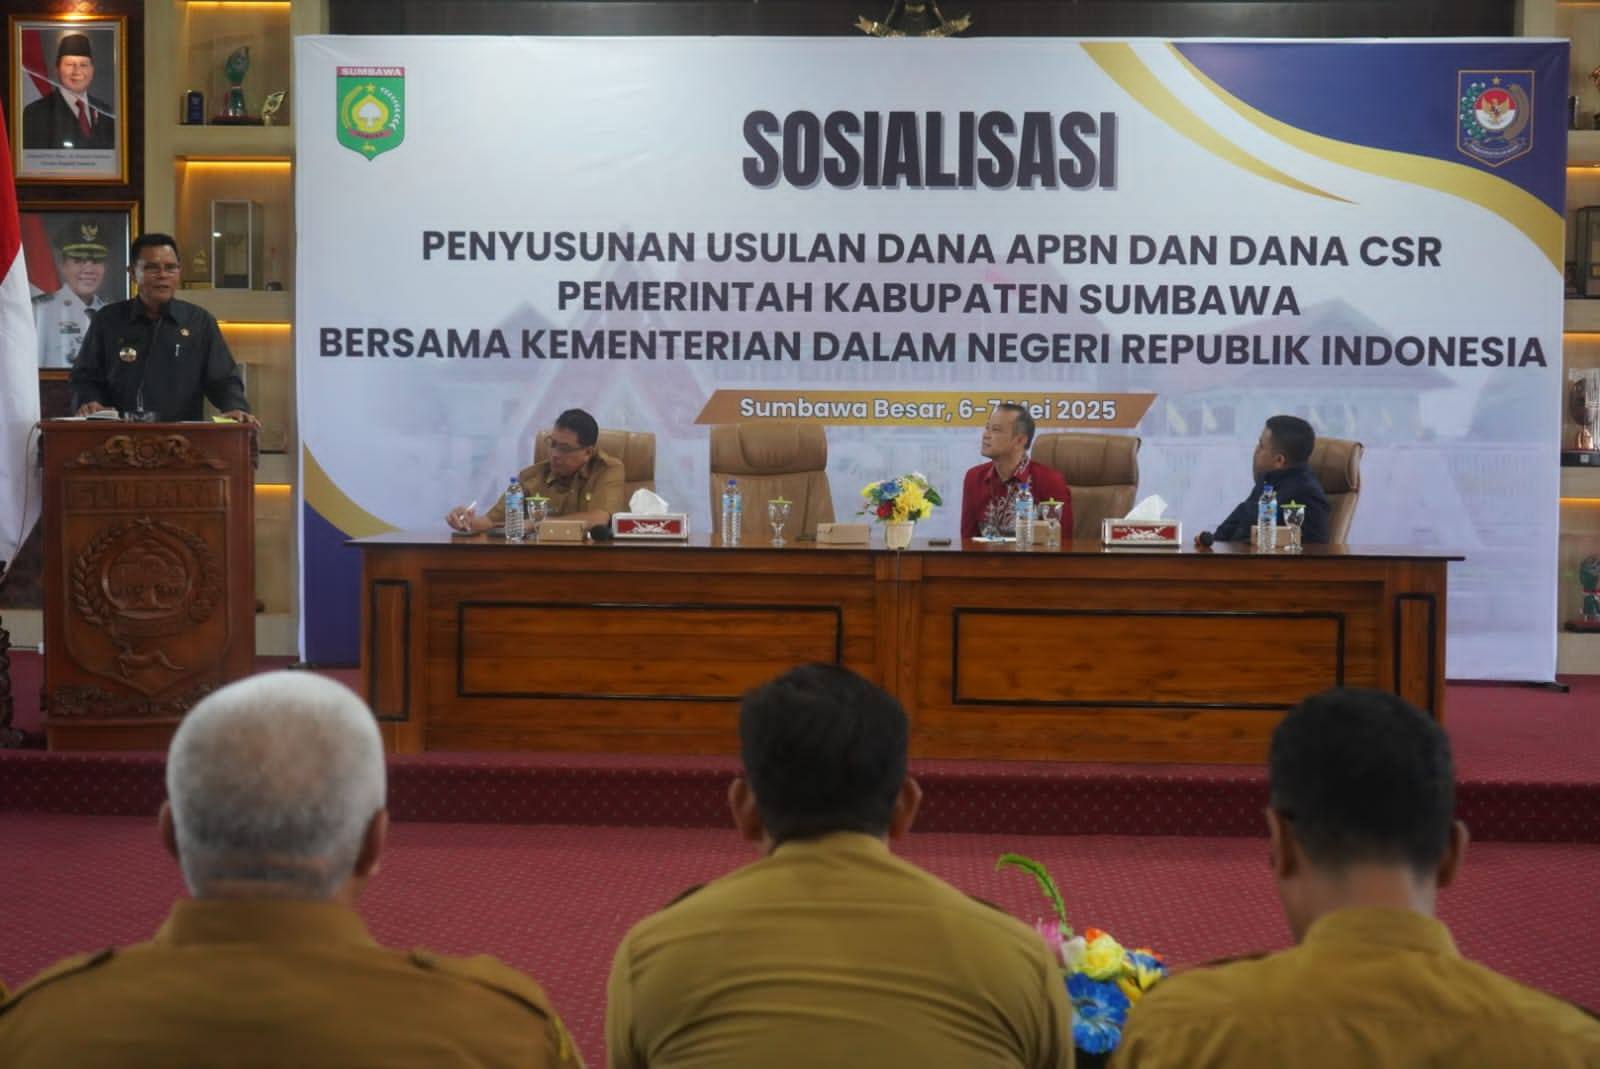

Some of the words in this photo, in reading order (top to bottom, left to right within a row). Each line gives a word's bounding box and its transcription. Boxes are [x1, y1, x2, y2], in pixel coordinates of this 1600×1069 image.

[340, 68, 401, 77] SUMBAWA
[742, 110, 1118, 190] SOSIALISASI
[423, 230, 695, 262] PENYUSUNAN
[707, 232, 866, 264] USULAN
[877, 233, 996, 265] DANA
[1005, 234, 1118, 265] APBN
[1129, 234, 1218, 266] DAN
[1230, 235, 1349, 267] DANA
[1359, 236, 1442, 267] CSR
[558, 280, 813, 313] PEMERINTAH
[824, 282, 1068, 315] KABUPATEN
[1079, 284, 1301, 316] SUMBAWA
[319, 327, 511, 359] BERSAMA
[521, 328, 801, 361] KEMENTERIAN
[812, 331, 957, 363] DALAM
[967, 332, 1110, 364] NEGERI
[1121, 333, 1311, 366] REPUBLIK
[1321, 335, 1548, 368] INDONESIA
[740, 398, 867, 418] Sumbawa
[874, 399, 953, 422] Besar,
[1056, 400, 1117, 420] 2025
